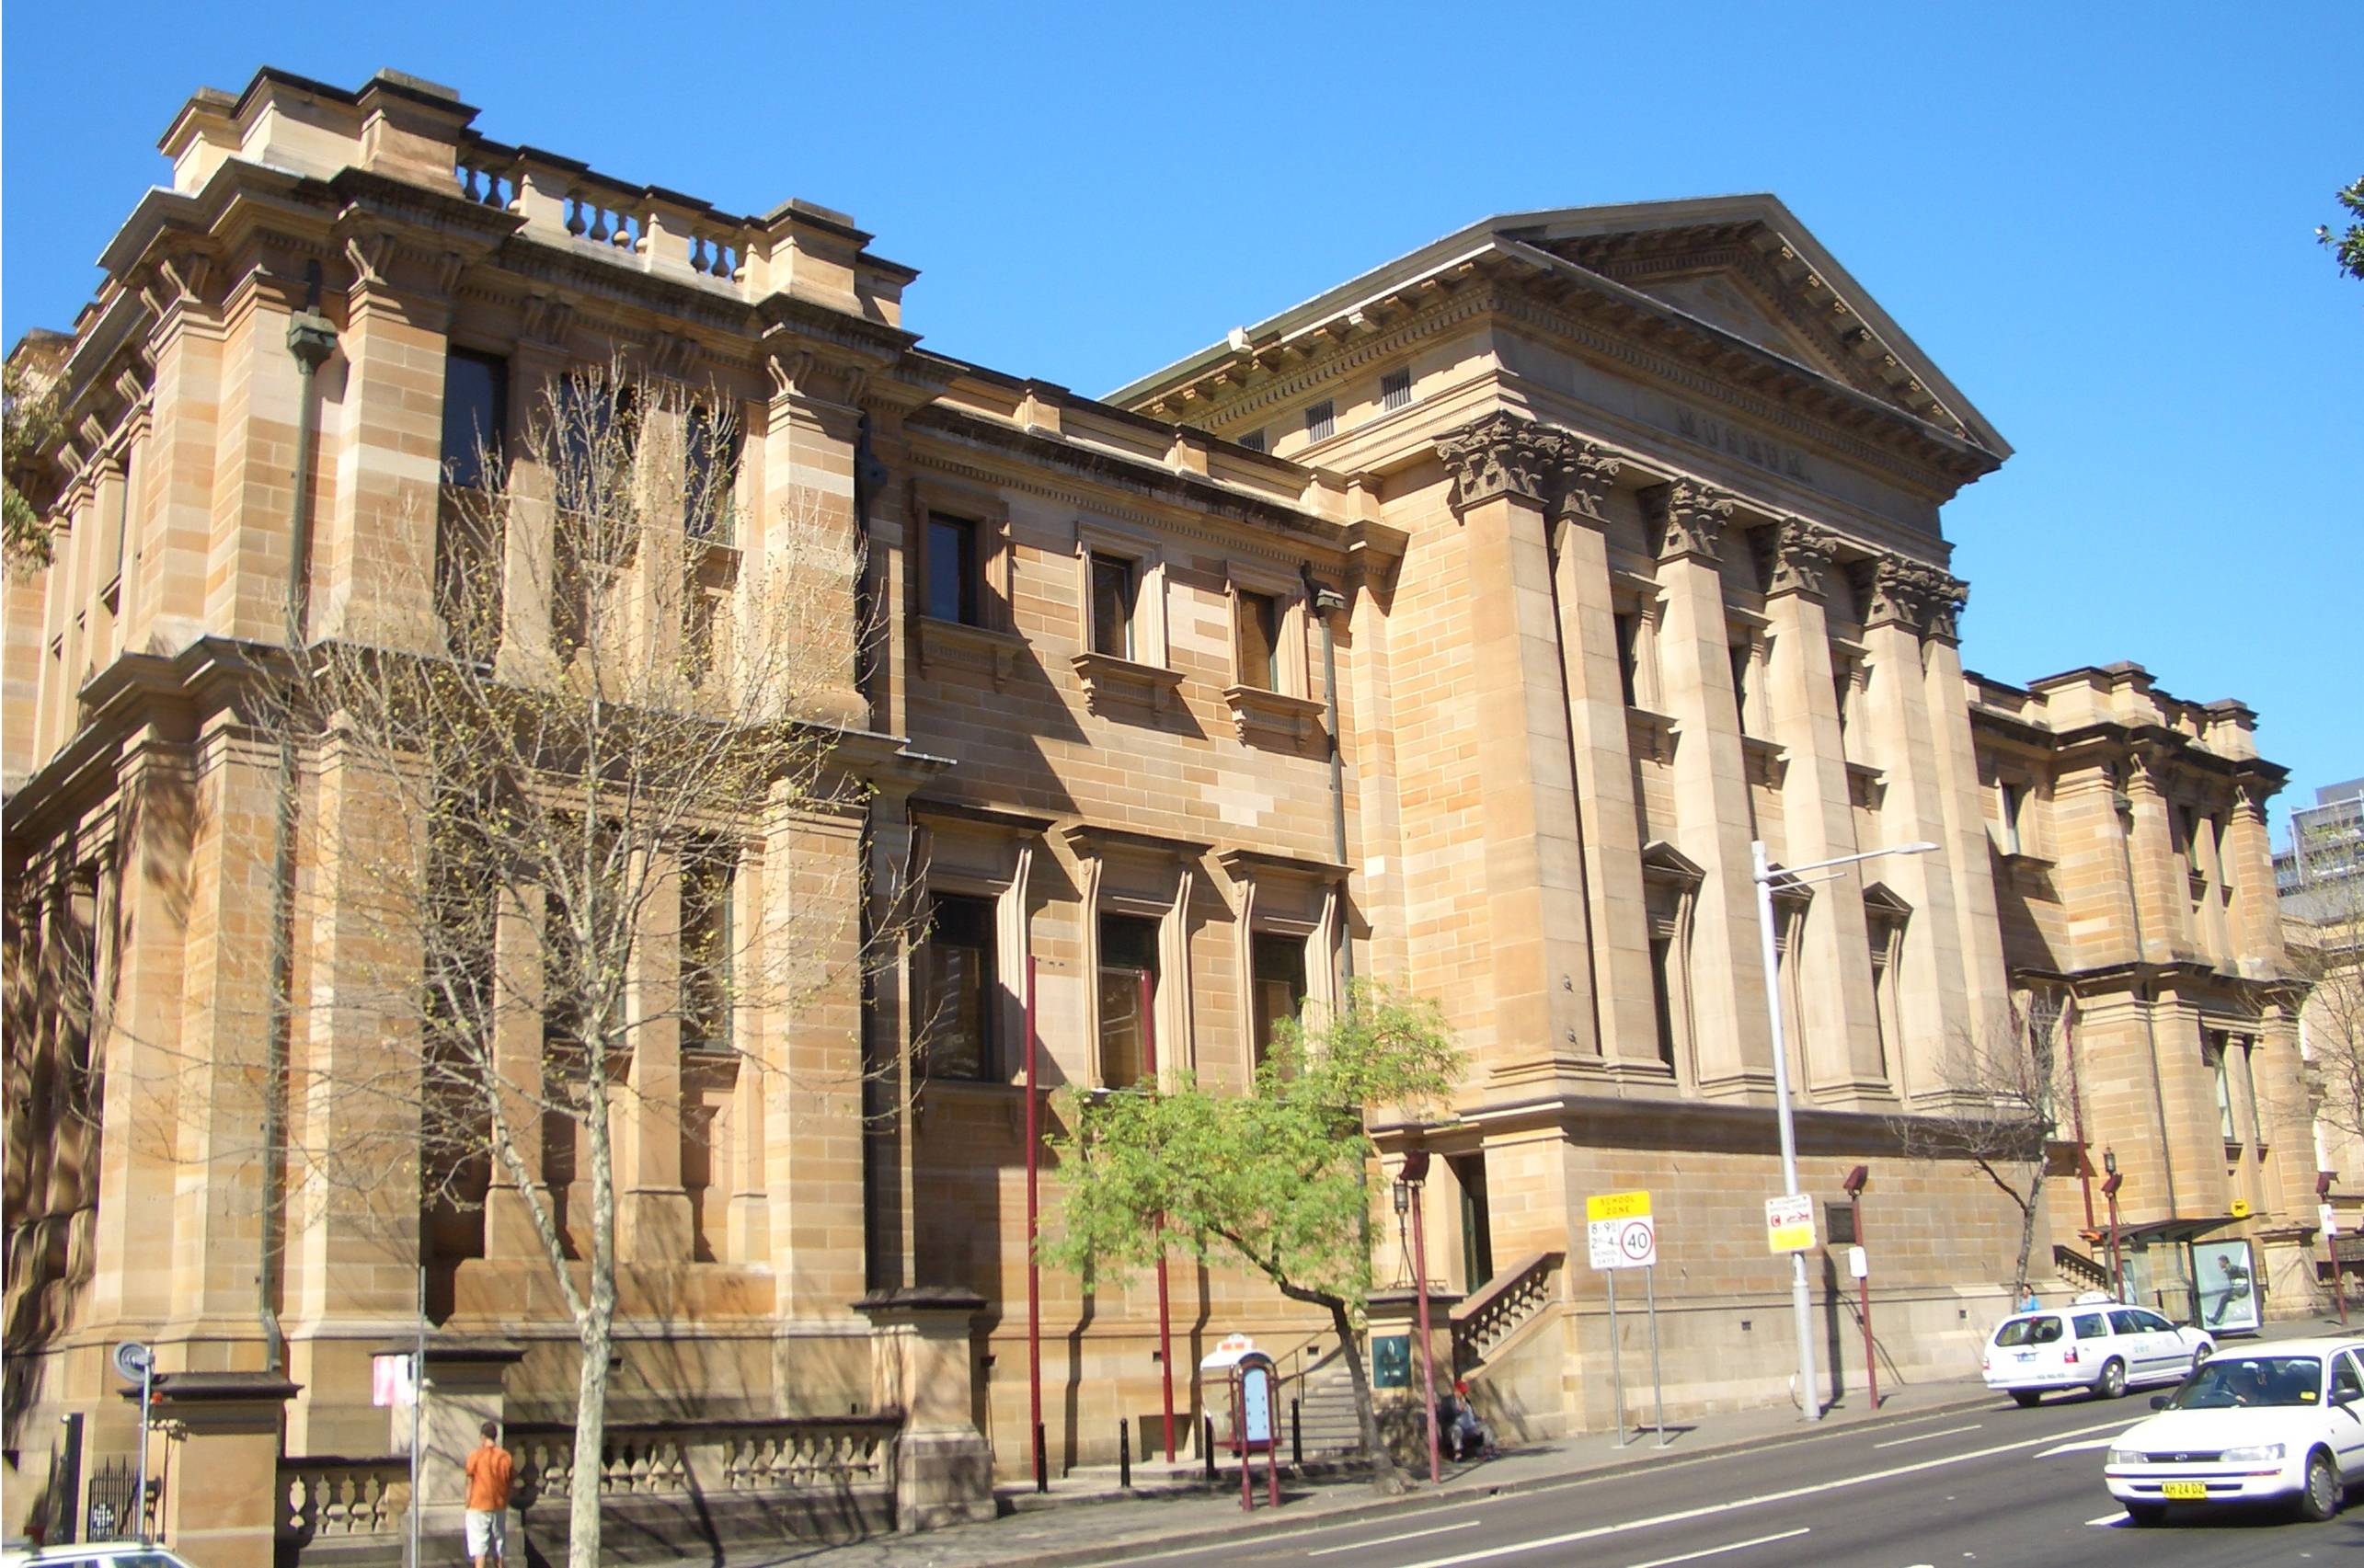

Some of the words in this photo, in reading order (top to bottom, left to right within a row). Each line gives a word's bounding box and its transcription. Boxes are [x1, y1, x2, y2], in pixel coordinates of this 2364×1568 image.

[1600, 1195, 1635, 1207] SCHOOL
[1606, 1205, 1630, 1215] ZONE
[1627, 1231, 1647, 1250] 40
